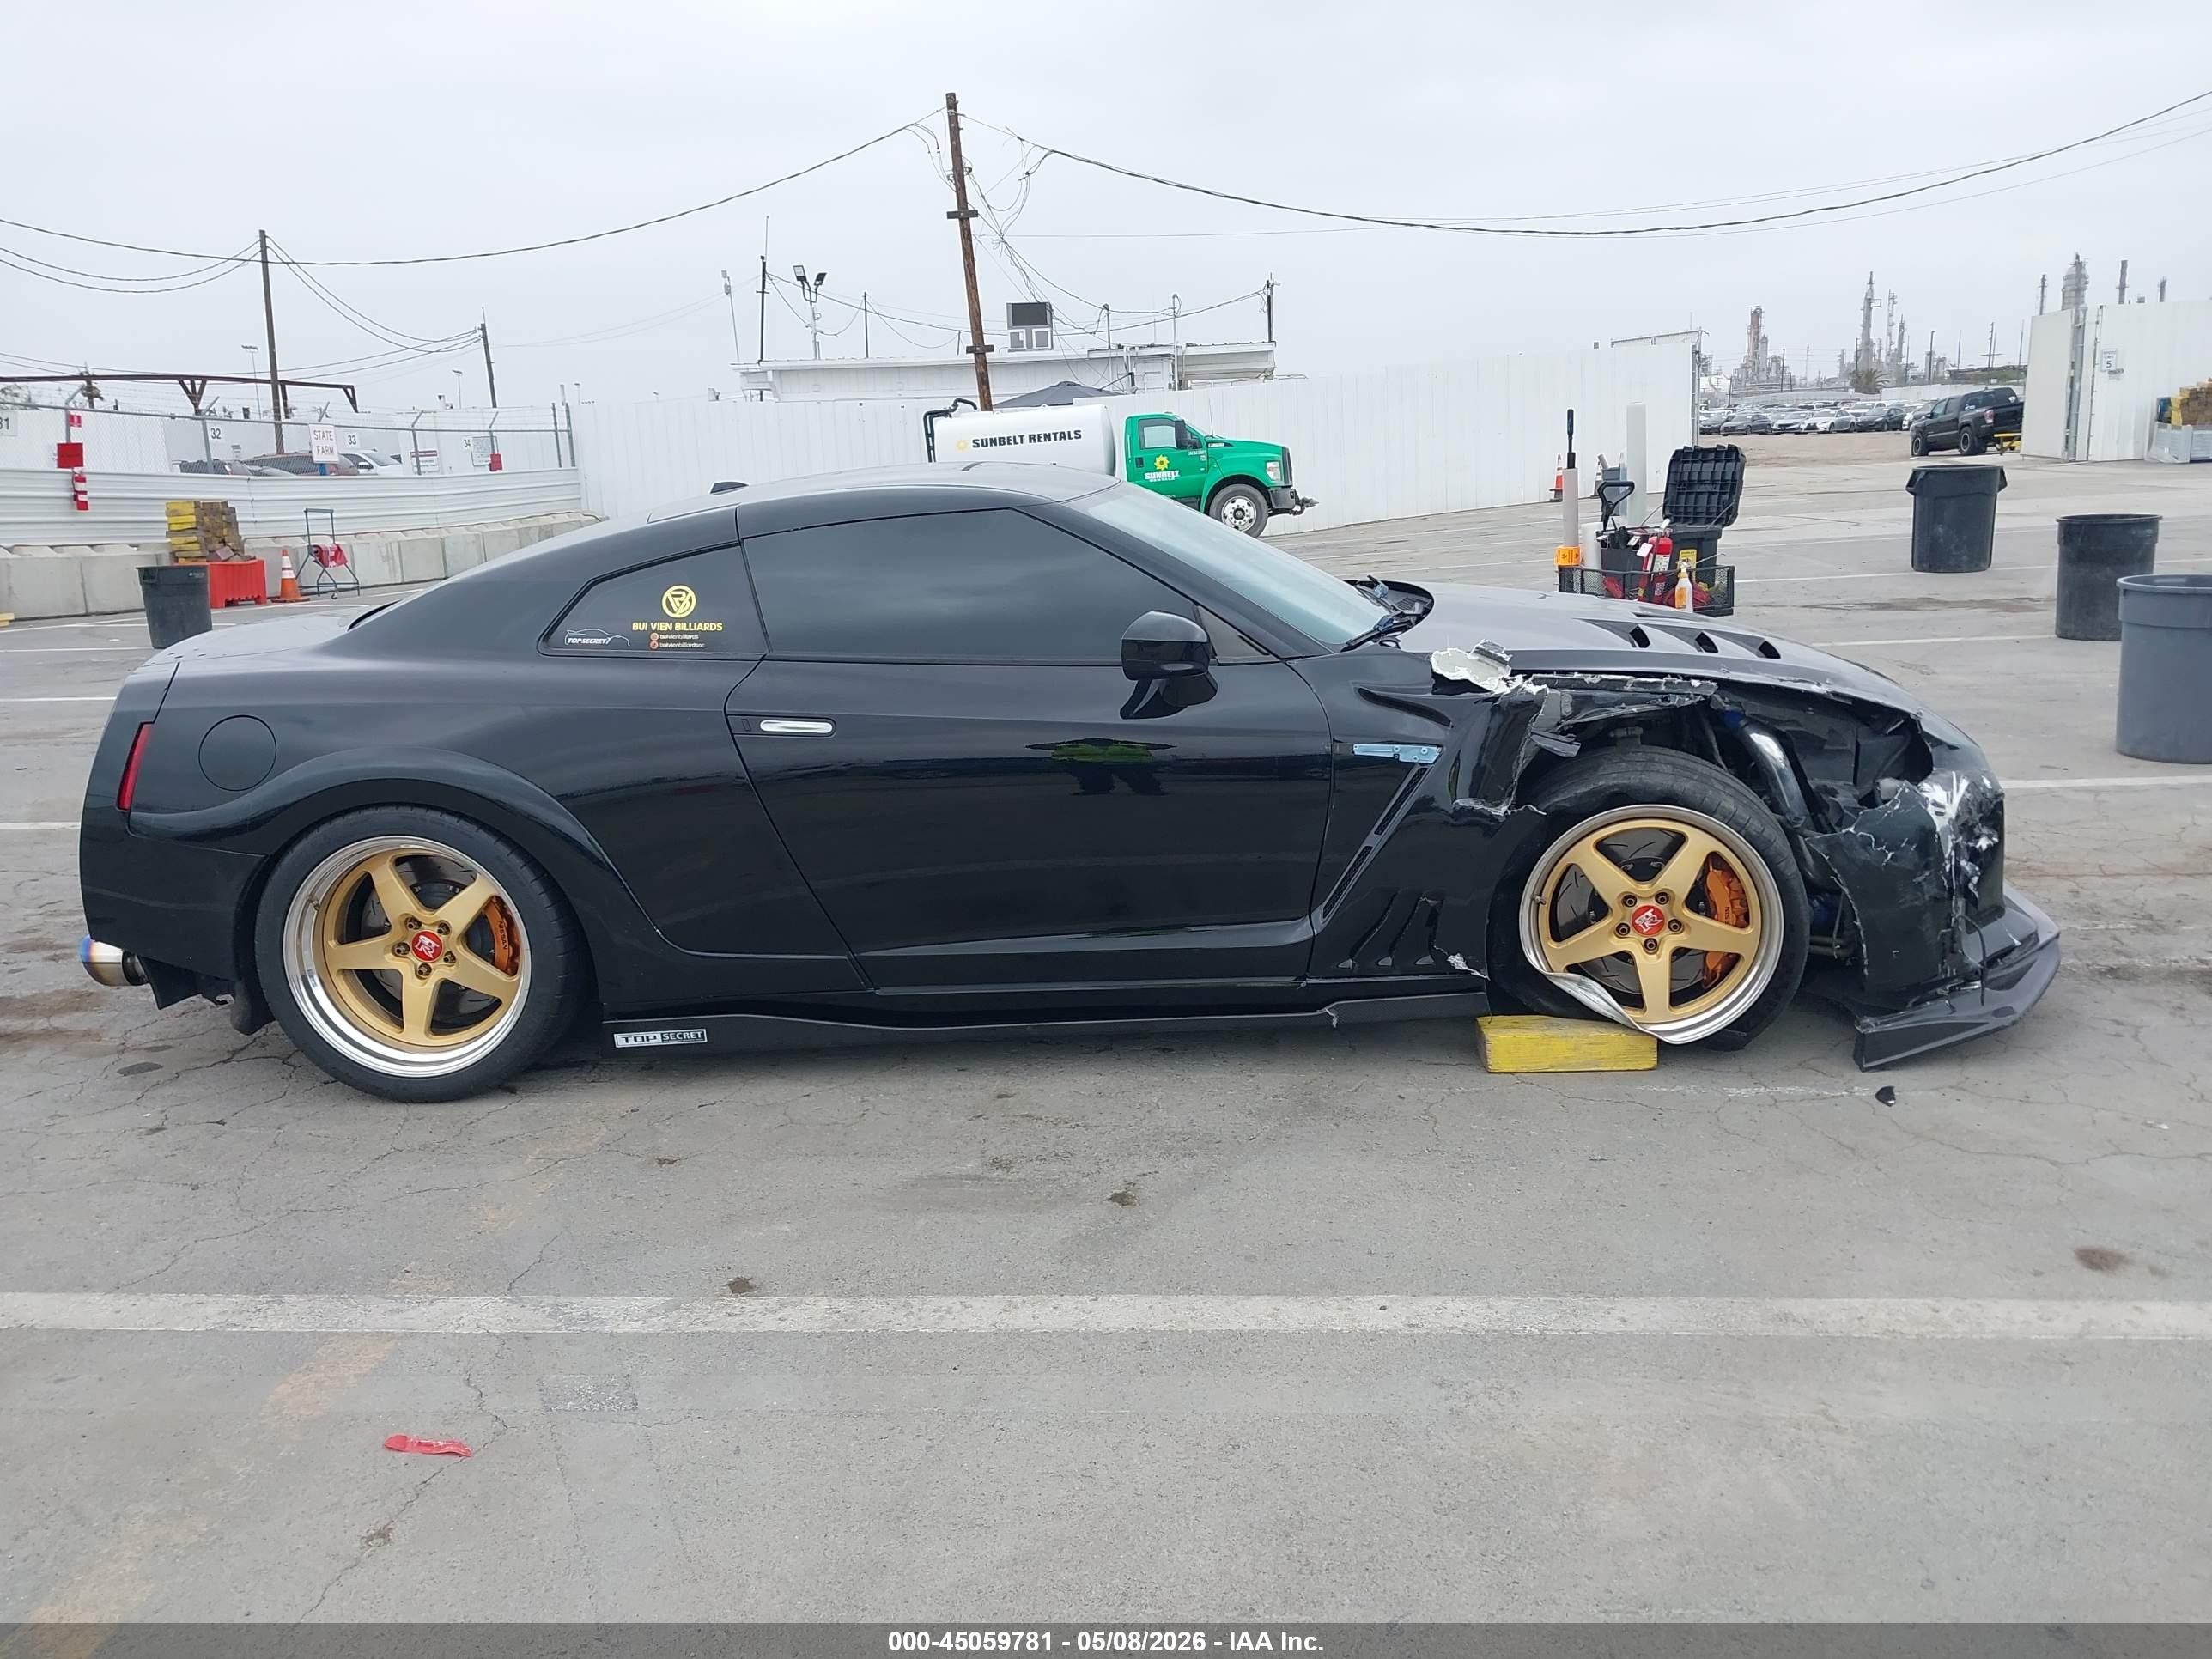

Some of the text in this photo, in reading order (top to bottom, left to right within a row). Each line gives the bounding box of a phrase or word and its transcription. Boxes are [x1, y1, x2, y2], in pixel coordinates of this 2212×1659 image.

[2106, 360, 2112, 368] 5
[210, 428, 222, 440] 32
[313, 429, 334, 441] STATE
[347, 434, 357, 445] 33
[972, 429, 1082, 448] SUNBELT RENTALS
[316, 445, 334, 455] FARM
[1144, 470, 1180, 480] SUNBELT
[632, 622, 723, 631] BUI VIEN BILLIARDS
[497, 921, 508, 950] NISSAN
[621, 1035, 658, 1044] TOP
[662, 1030, 702, 1041] SECRET
